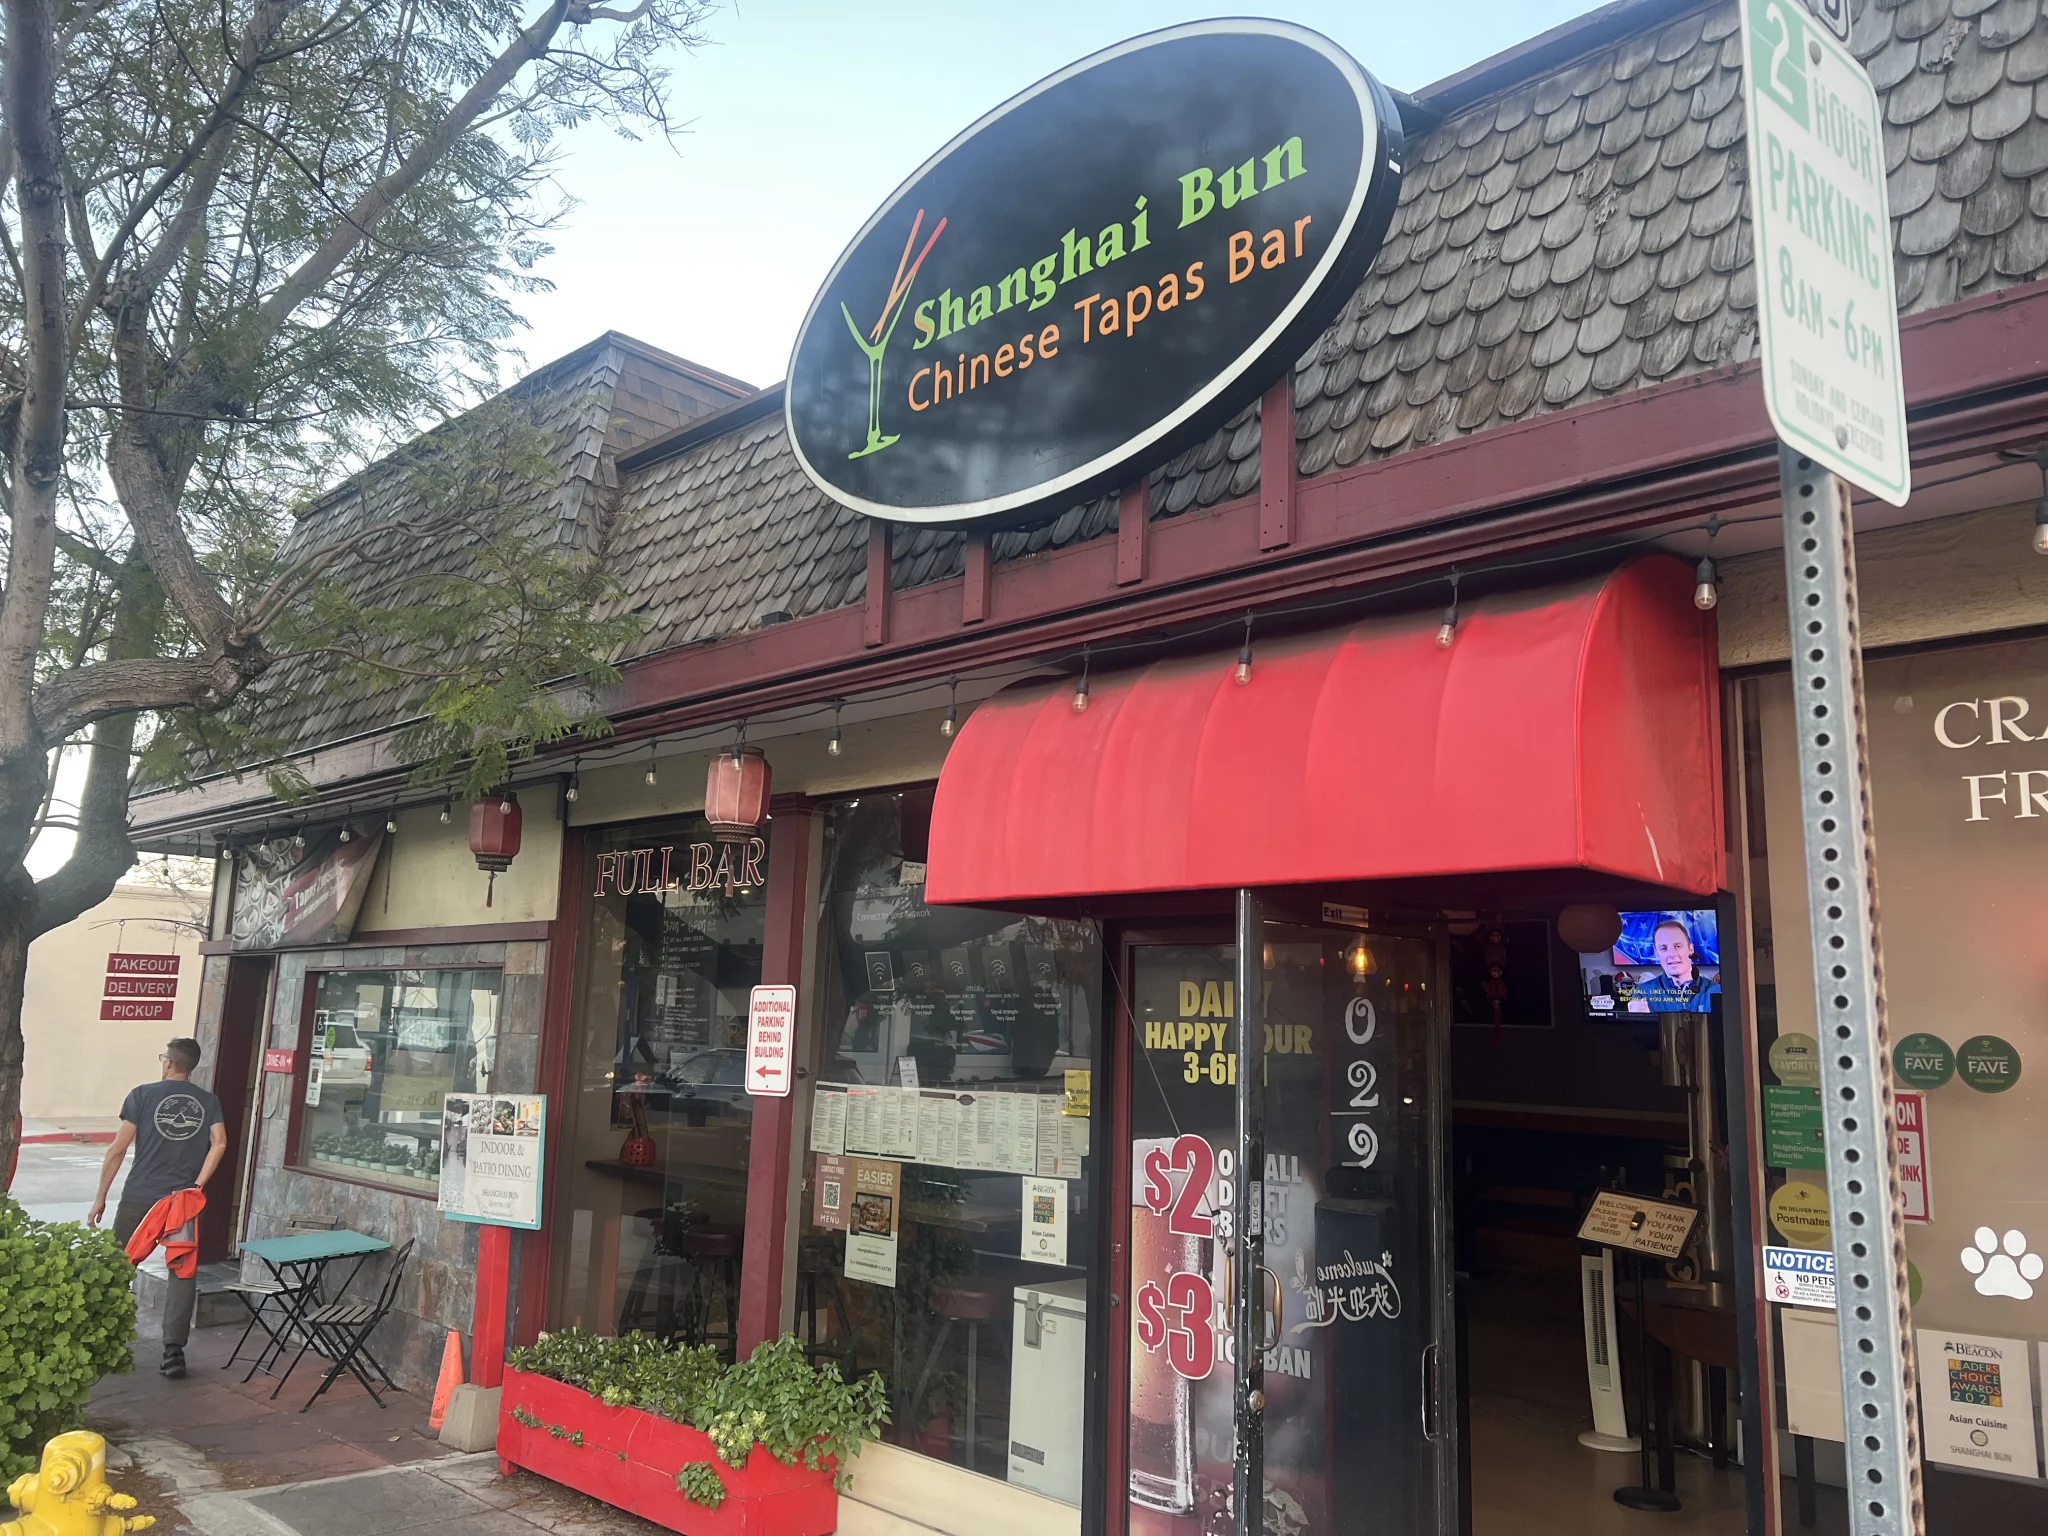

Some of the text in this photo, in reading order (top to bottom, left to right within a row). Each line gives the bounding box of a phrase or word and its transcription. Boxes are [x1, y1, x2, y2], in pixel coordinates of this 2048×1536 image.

[1766, 11, 1873, 186] 2 HOUR
[1767, 130, 1880, 290] PARKING
[913, 136, 1308, 350] Shanghai Bun
[908, 215, 1312, 412] Chinese Tapas Bar
[1790, 357, 1885, 437] SUNDAY AND CERTAIN
[594, 838, 765, 897] FULL BAR
[857, 912, 880, 921] Connect
[1324, 907, 1343, 919] Exit
[113, 958, 176, 971] TAKEOUT
[108, 981, 174, 994] DELIVERY
[754, 1001, 790, 1012] ADDITIONAL
[1179, 981, 1274, 1018] DAI
[112, 1005, 163, 1017] PICKUP
[757, 1016, 785, 1028] PARKING
[758, 1031, 782, 1043] BEHIND
[1145, 1022, 1314, 1055] HAPPY OUR
[754, 1046, 784, 1058] BUILDING
[266, 1054, 287, 1067] DINE-IN
[1904, 1057, 1944, 1071] FAVE
[1968, 1060, 2009, 1074] FAVE
[1183, 1051, 1268, 1087] 3-6P
[1771, 1110, 1801, 1118] Favorite
[481, 1140, 525, 1157] INDOOR &
[1773, 1151, 1803, 1160] Favorite
[473, 1161, 532, 1179] PATIO DINING
[857, 1169, 893, 1186] EASIER
[1900, 1163, 1921, 1182] INK
[1144, 1133, 1215, 1239] $2
[1264, 1153, 1303, 1184] ALL
[482, 1188, 519, 1200] SHANGHAI BUN
[1034, 1203, 1054, 1211] CHOICE
[1252, 1185, 1260, 1231] PUSH
[1595, 1208, 1619, 1217] PLEASE
[1599, 1199, 1641, 1213] WELCOME
[1789, 1206, 1812, 1214] DELIVER
[820, 1214, 839, 1224] MENU
[1655, 1211, 1686, 1223] THANK
[1777, 1212, 1831, 1227] Postmates
[1591, 1226, 1621, 1237] ASSISTED
[1646, 1219, 1686, 1234] YOU FOR
[1649, 1230, 1674, 1242] YOUR
[1634, 1238, 1680, 1253] PATIENCE
[1769, 1251, 1834, 1272] NOTICE
[1796, 1274, 1835, 1287] NO PETS
[1136, 1271, 1215, 1380] $3
[1218, 1333, 1311, 1379] ICBAN
[1956, 1342, 2003, 1359] BEACON
[1948, 1360, 1999, 1374] READERS
[1950, 1370, 2000, 1385] CHOICE
[1951, 1381, 2001, 1396] AWARDS
[1949, 1413, 2008, 1430] Asian Cuisine
[1950, 1445, 2012, 1462] SHANGHAI BUN
